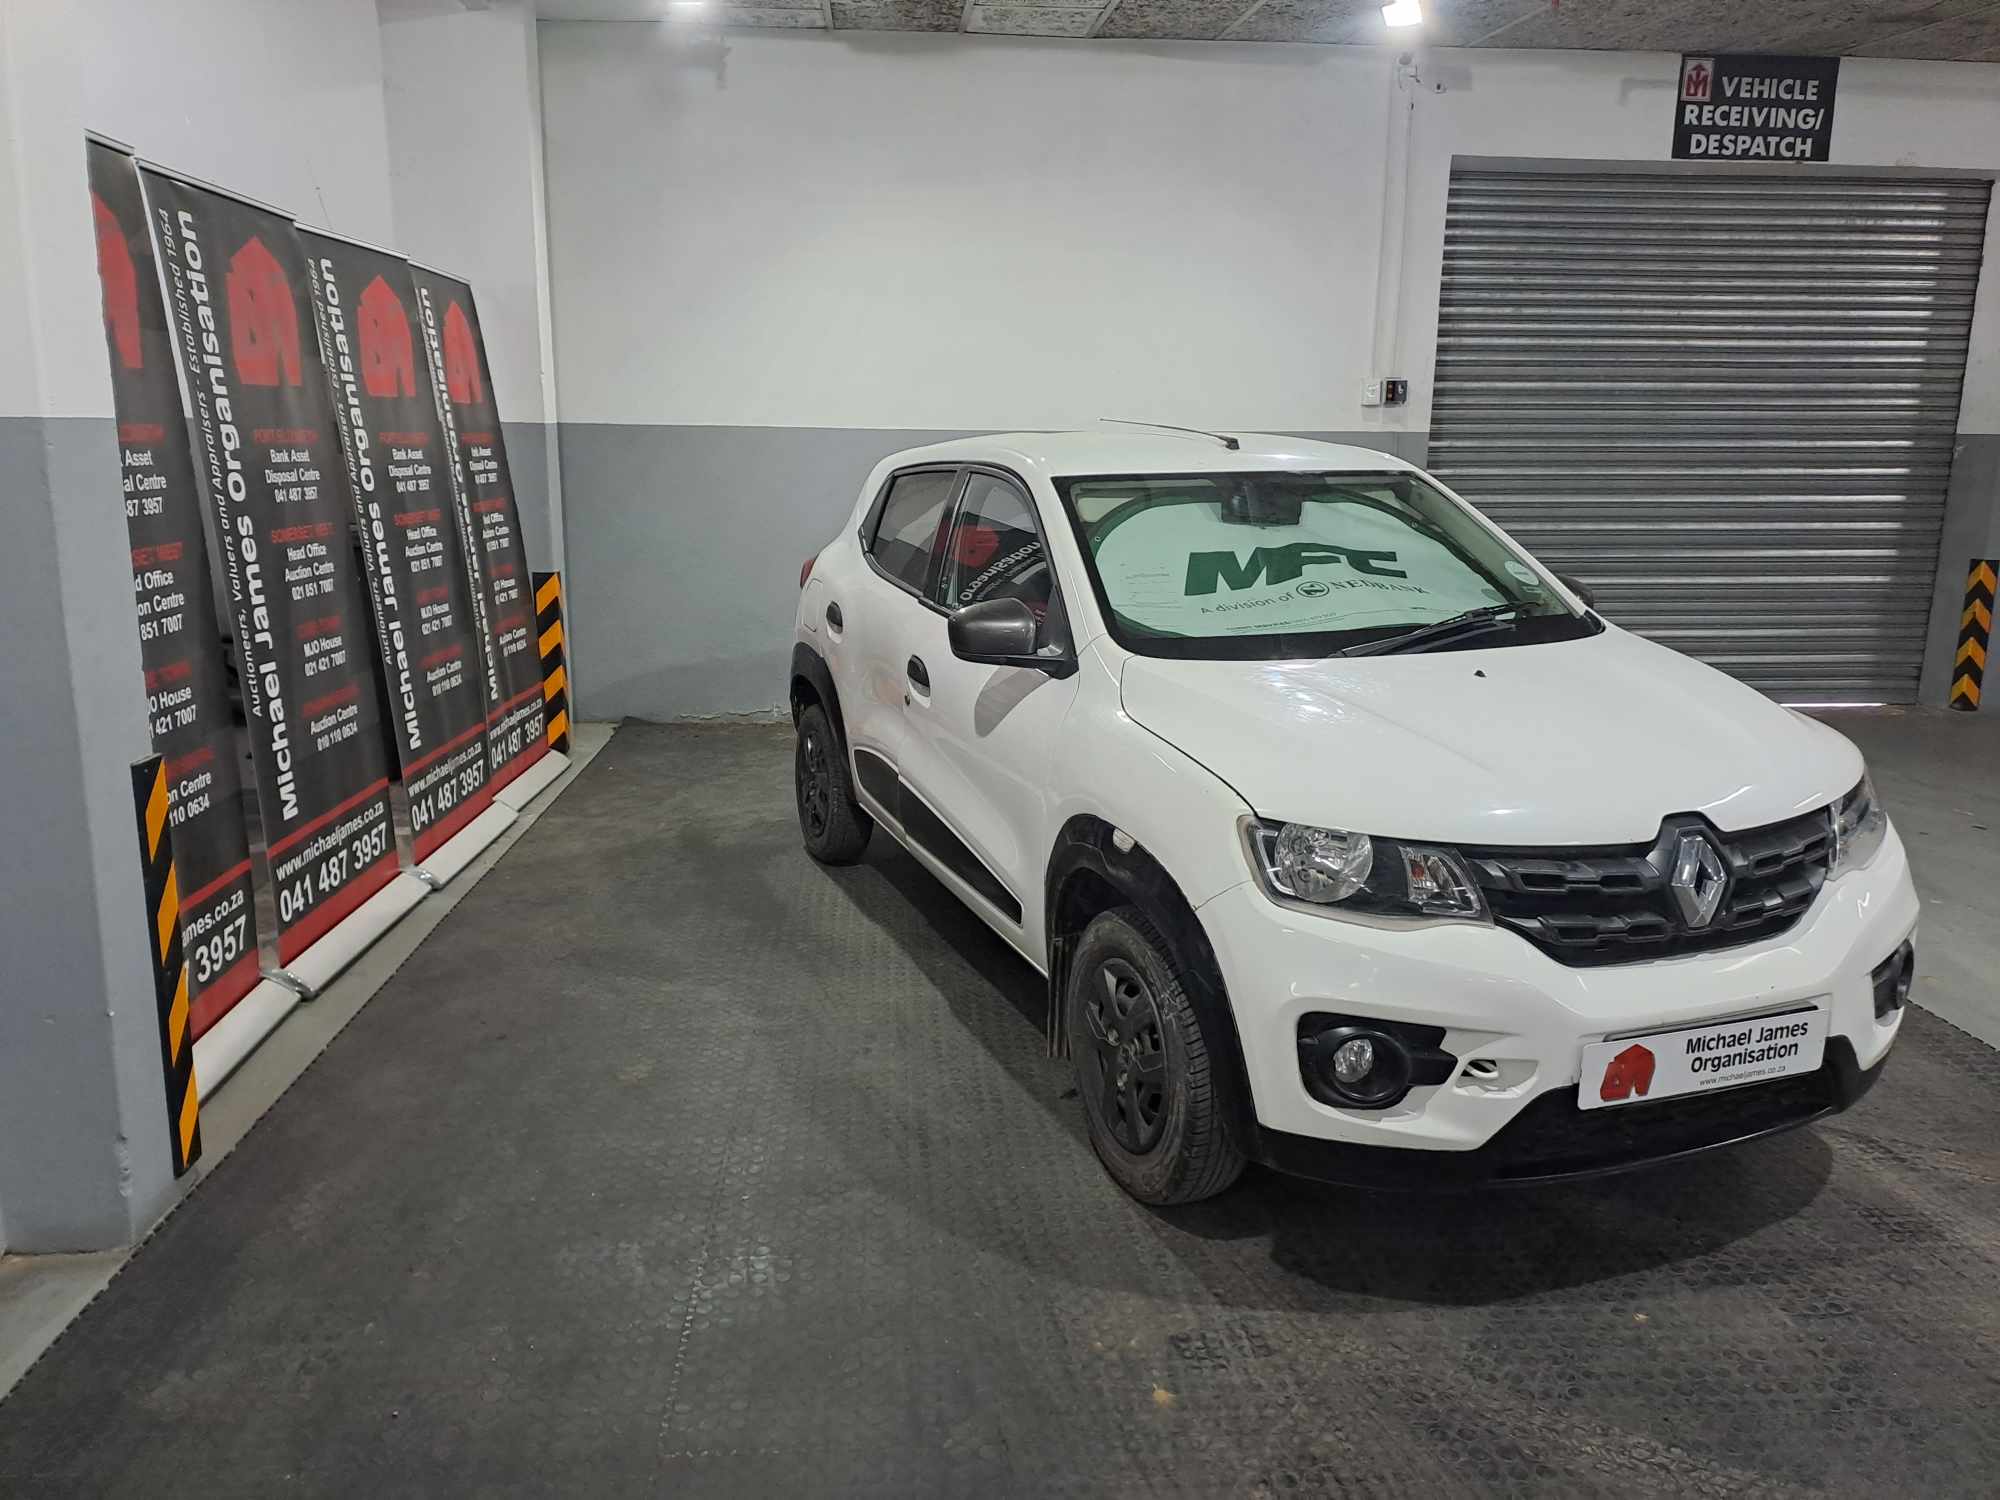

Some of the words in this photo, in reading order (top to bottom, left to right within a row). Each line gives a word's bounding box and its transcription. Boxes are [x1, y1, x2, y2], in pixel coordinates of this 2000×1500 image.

[1721, 76, 1820, 101] VEHICLE
[1683, 104, 1825, 131] RECEIVING/
[1689, 133, 1813, 158] DESPATCH
[158, 208, 177, 257] 1964
[168, 262, 200, 374] Established
[178, 210, 246, 502] Organisation
[320, 258, 375, 492] Organisation
[197, 391, 224, 490] Appraisers
[270, 449, 290, 463] Bank
[125, 449, 153, 467] Asset
[136, 473, 167, 490] Centre
[265, 468, 298, 486] Disposal
[142, 496, 163, 515] 3957
[214, 493, 230, 530] and
[224, 535, 243, 601] Valuers
[368, 502, 398, 612] James
[1184, 542, 1408, 596] MFC
[144, 570, 174, 589] Office
[237, 515, 273, 649] James
[153, 592, 185, 612] Centre
[1200, 607, 1210, 615] A
[1215, 598, 1277, 613] division
[1278, 592, 1295, 602] of
[140, 620, 159, 640] 851
[161, 613, 183, 635] 7007
[159, 686, 192, 711] House
[388, 620, 422, 750] Michael
[155, 714, 173, 736] 421
[174, 703, 197, 727] 7007
[259, 661, 299, 821] Michael
[490, 739, 507, 769] 041
[507, 727, 522, 756] 487
[524, 712, 544, 744] 3957
[180, 771, 212, 798] Centre
[411, 794, 435, 832] 041
[437, 778, 458, 812] 487
[459, 758, 484, 797] 3957
[187, 793, 211, 818] 0634
[276, 801, 385, 882] www.michaeljames.co.za
[280, 873, 313, 922] 041
[318, 848, 348, 892] 487
[352, 821, 387, 870] 3957
[195, 914, 246, 983] 3957
[1686, 1028, 1752, 1055] Michael
[1755, 1022, 1809, 1044] James
[1691, 1042, 1799, 1073] Organisation
